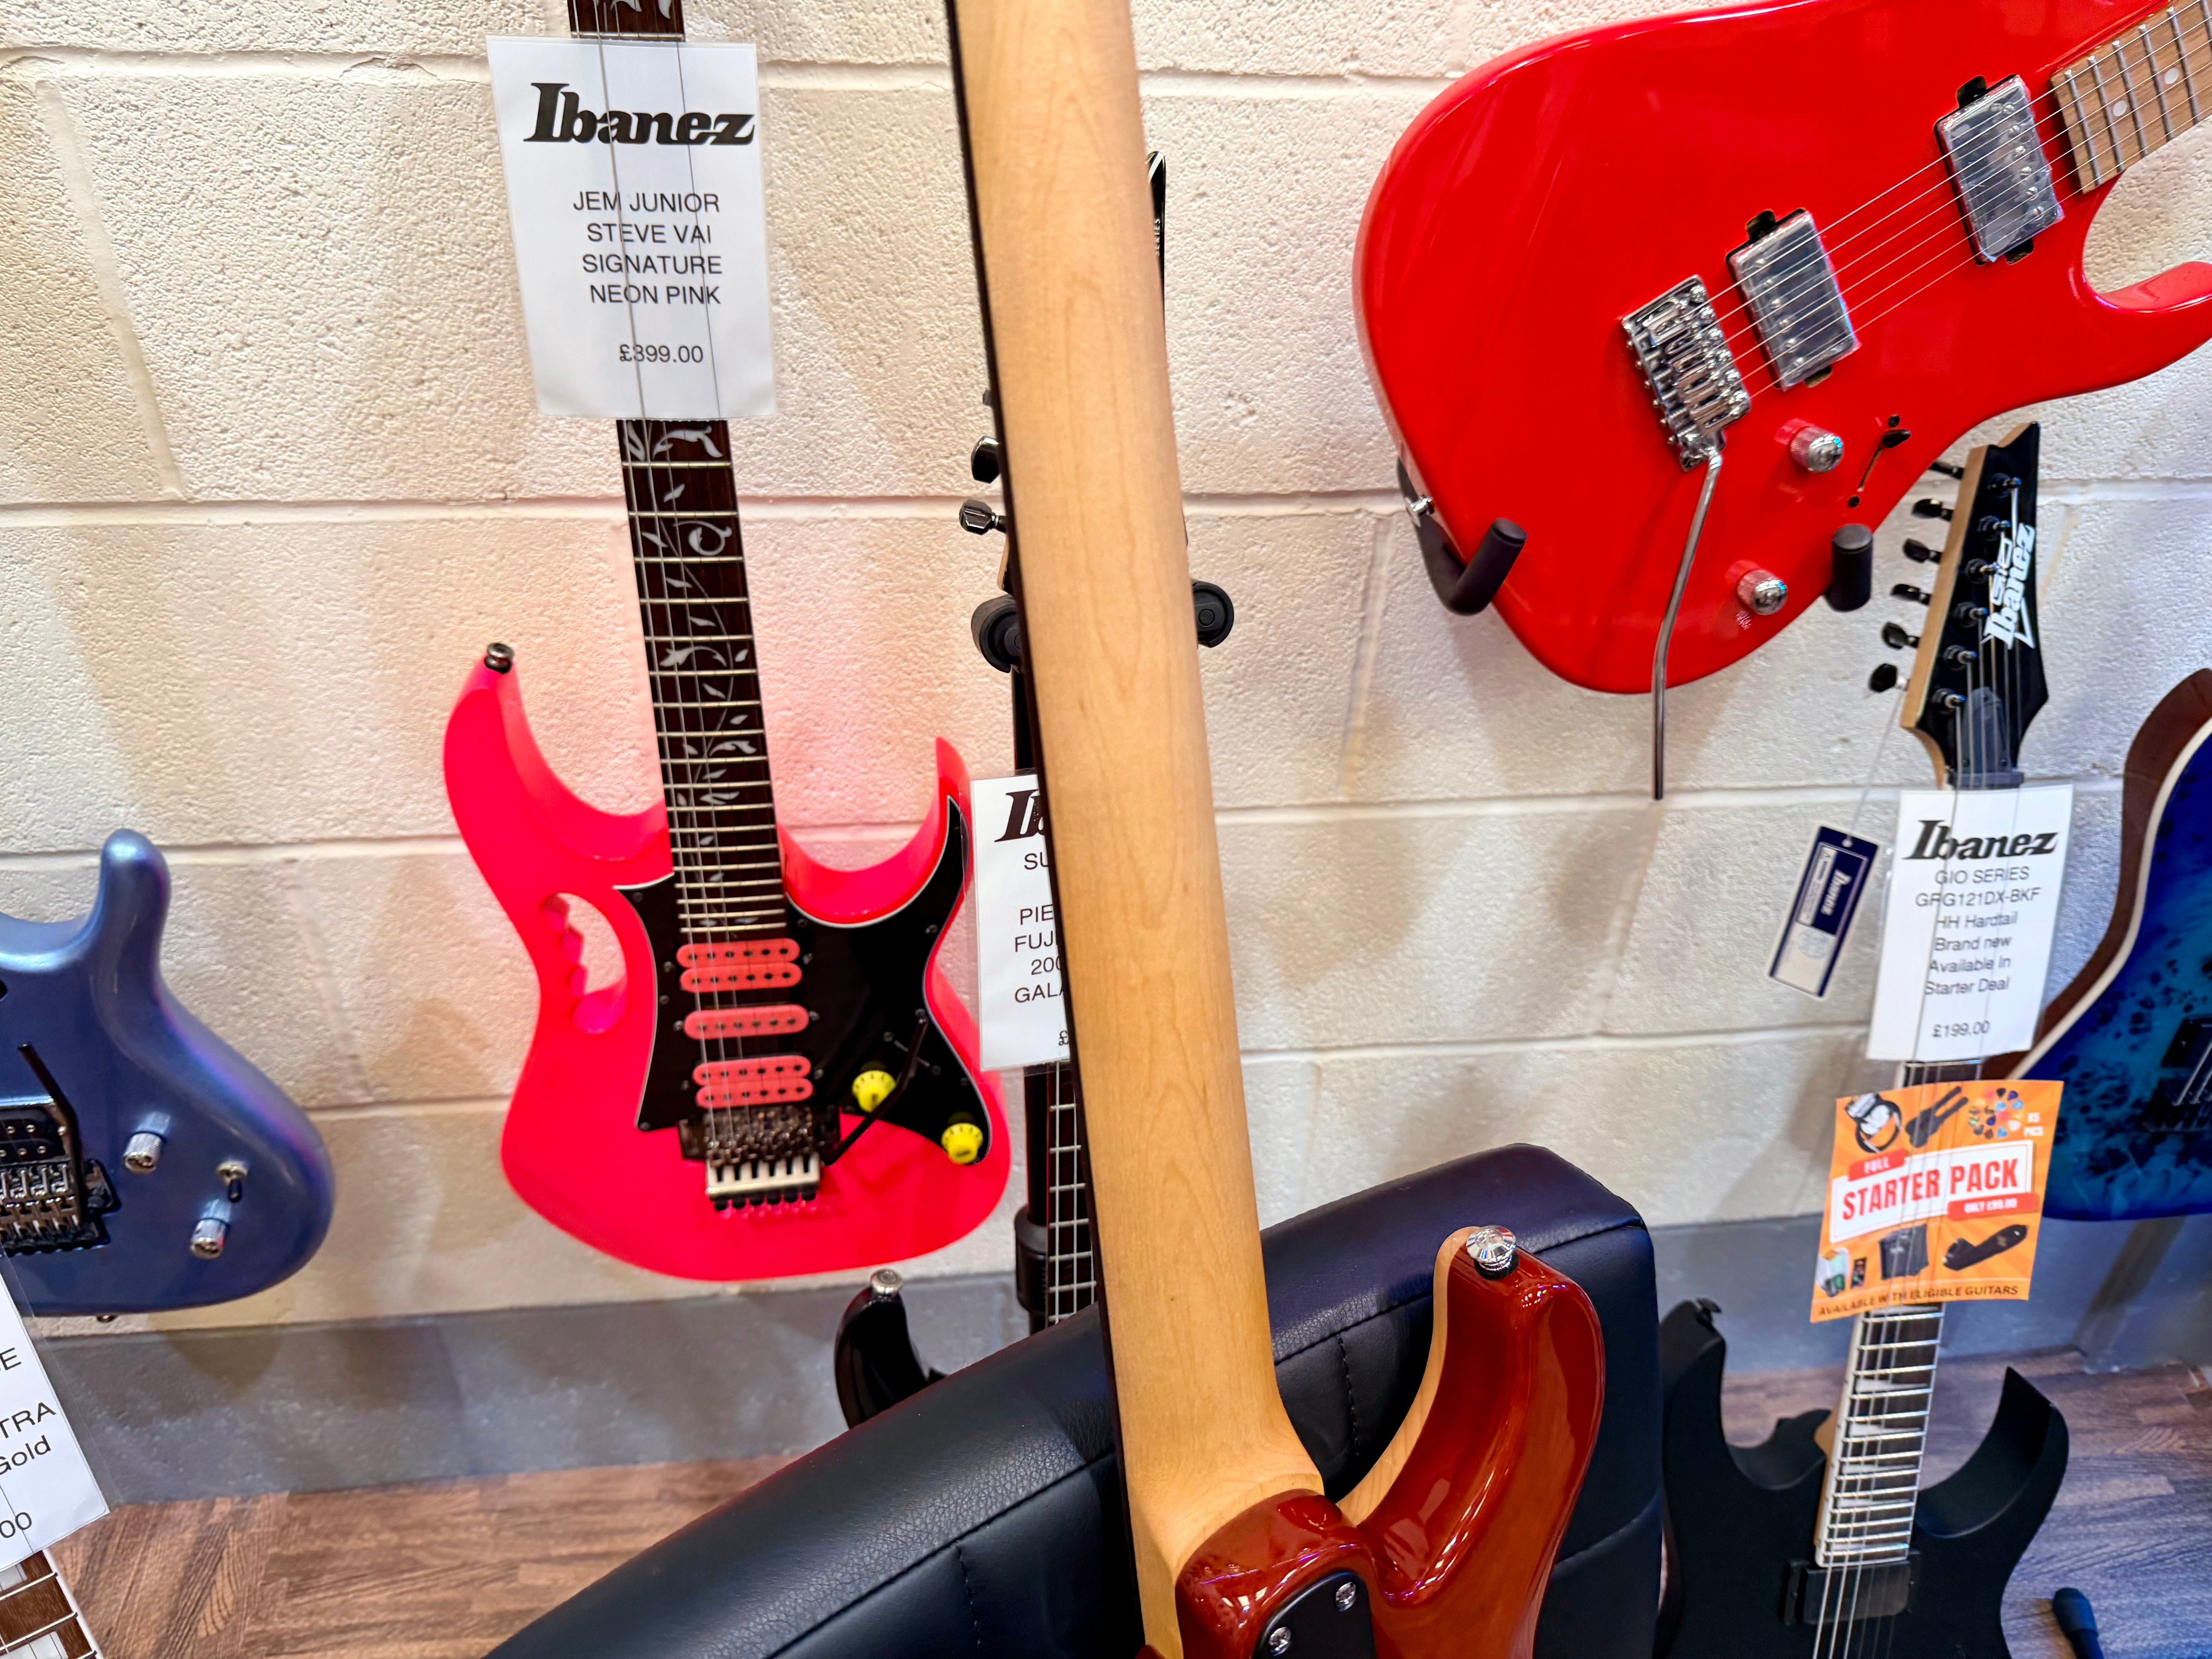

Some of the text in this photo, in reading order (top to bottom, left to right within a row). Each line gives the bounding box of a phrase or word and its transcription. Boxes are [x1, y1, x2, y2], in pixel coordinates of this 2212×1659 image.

[523, 82, 755, 145] Ibanez
[573, 191, 720, 213] JEM JUNIOR
[587, 223, 711, 244] STEVE VAI
[582, 254, 723, 274] SIGNATURE
[590, 285, 721, 304] NEON PINK
[619, 344, 704, 363] £399.00
[1983, 522, 2035, 650] Ibanez
[1902, 819, 2059, 860] Ibanez
[1935, 866, 2030, 884] GIO SERIES
[1964, 910, 2018, 928] Hardtail
[1015, 930, 1058, 952] FUJ
[1934, 936, 2012, 951] Brand new
[1930, 957, 1994, 973] Available
[1015, 982, 1063, 1003] GAL
[1924, 975, 2010, 995] Starter Deal
[1932, 1020, 1990, 1037] £199.00
[1842, 1159, 2019, 1221] STARTER PACK
[1965, 1285, 2018, 1296] GUITARS
